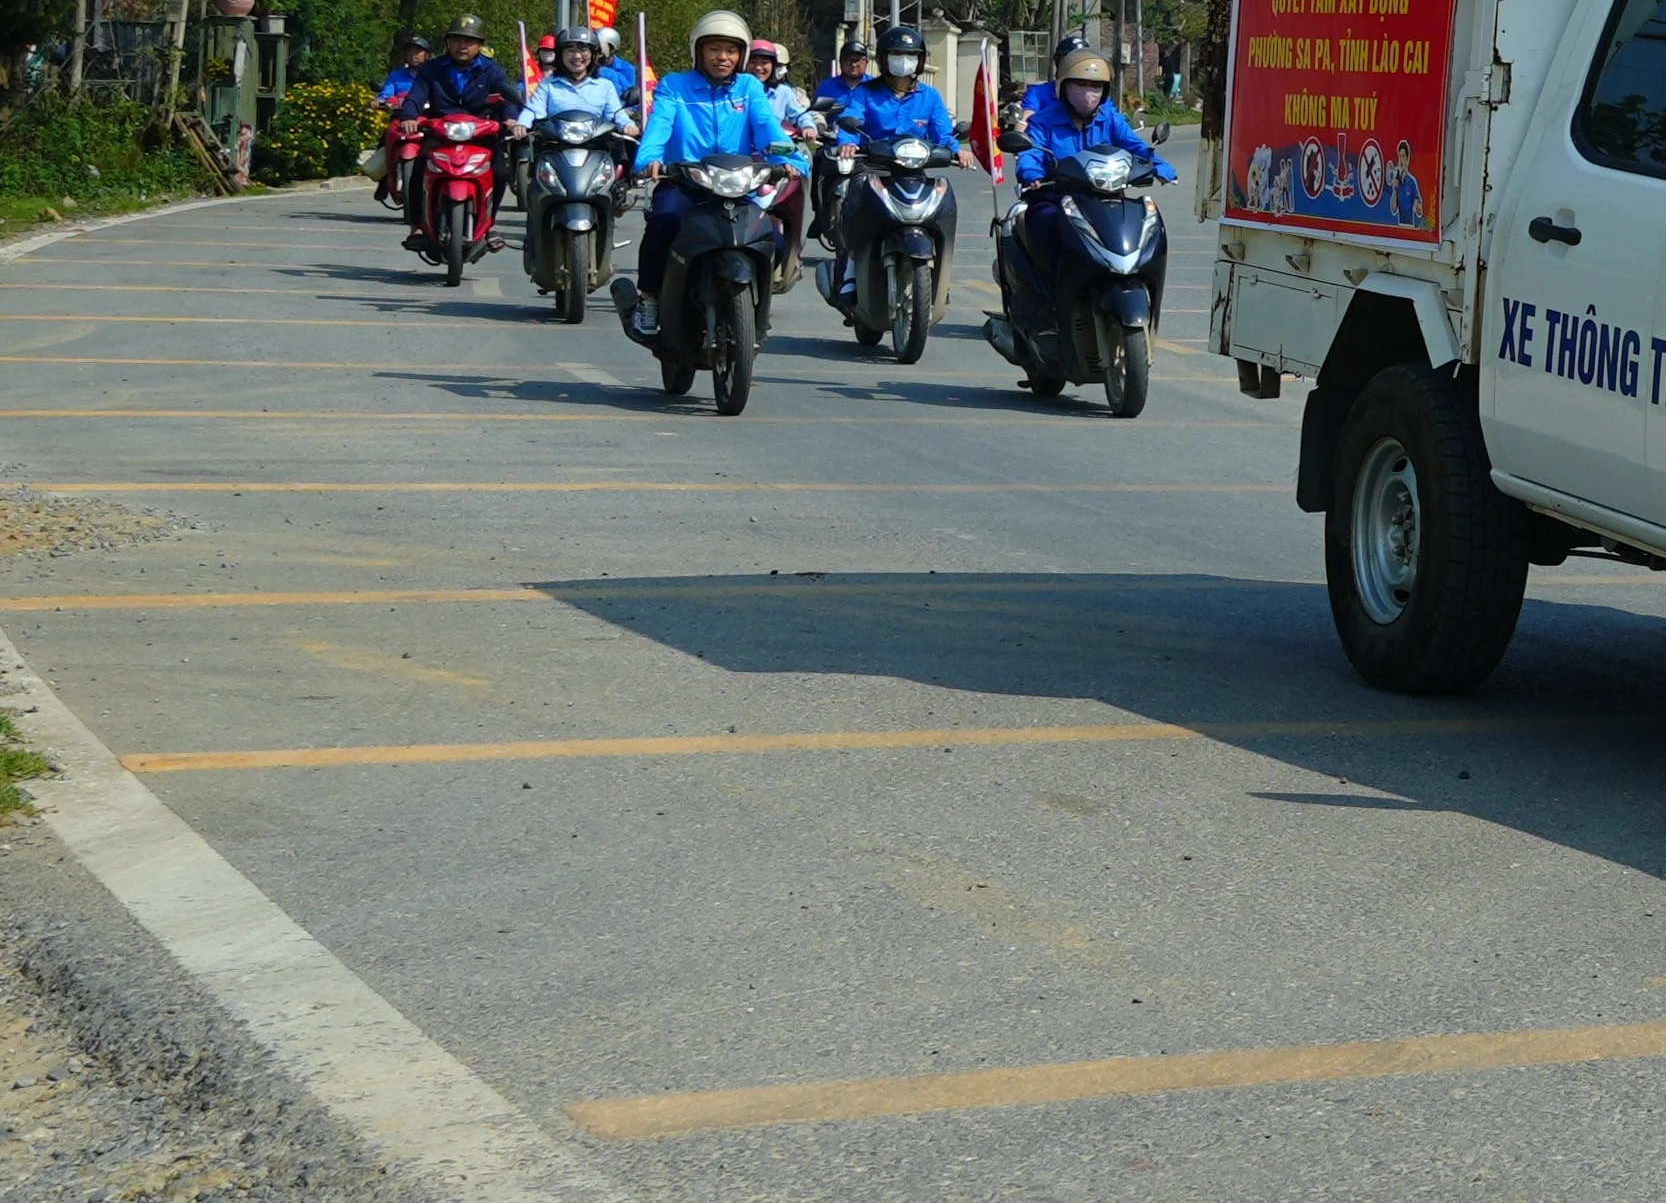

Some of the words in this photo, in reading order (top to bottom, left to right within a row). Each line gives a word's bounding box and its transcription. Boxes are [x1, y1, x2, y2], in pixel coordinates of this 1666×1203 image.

[1248, 30, 1293, 70] PHƯỜNG
[1296, 37, 1311, 70] SA
[1315, 38, 1335, 75] PA,
[1339, 28, 1369, 72] TỈNH
[1372, 33, 1400, 73] LÀO
[1403, 40, 1430, 74] CAI
[1284, 87, 1326, 128] KHÔNG
[1330, 96, 1349, 129] MA
[1354, 91, 1378, 130] TUÝ
[1498, 297, 1537, 368] XE
[1544, 304, 1640, 398] THÔNG
